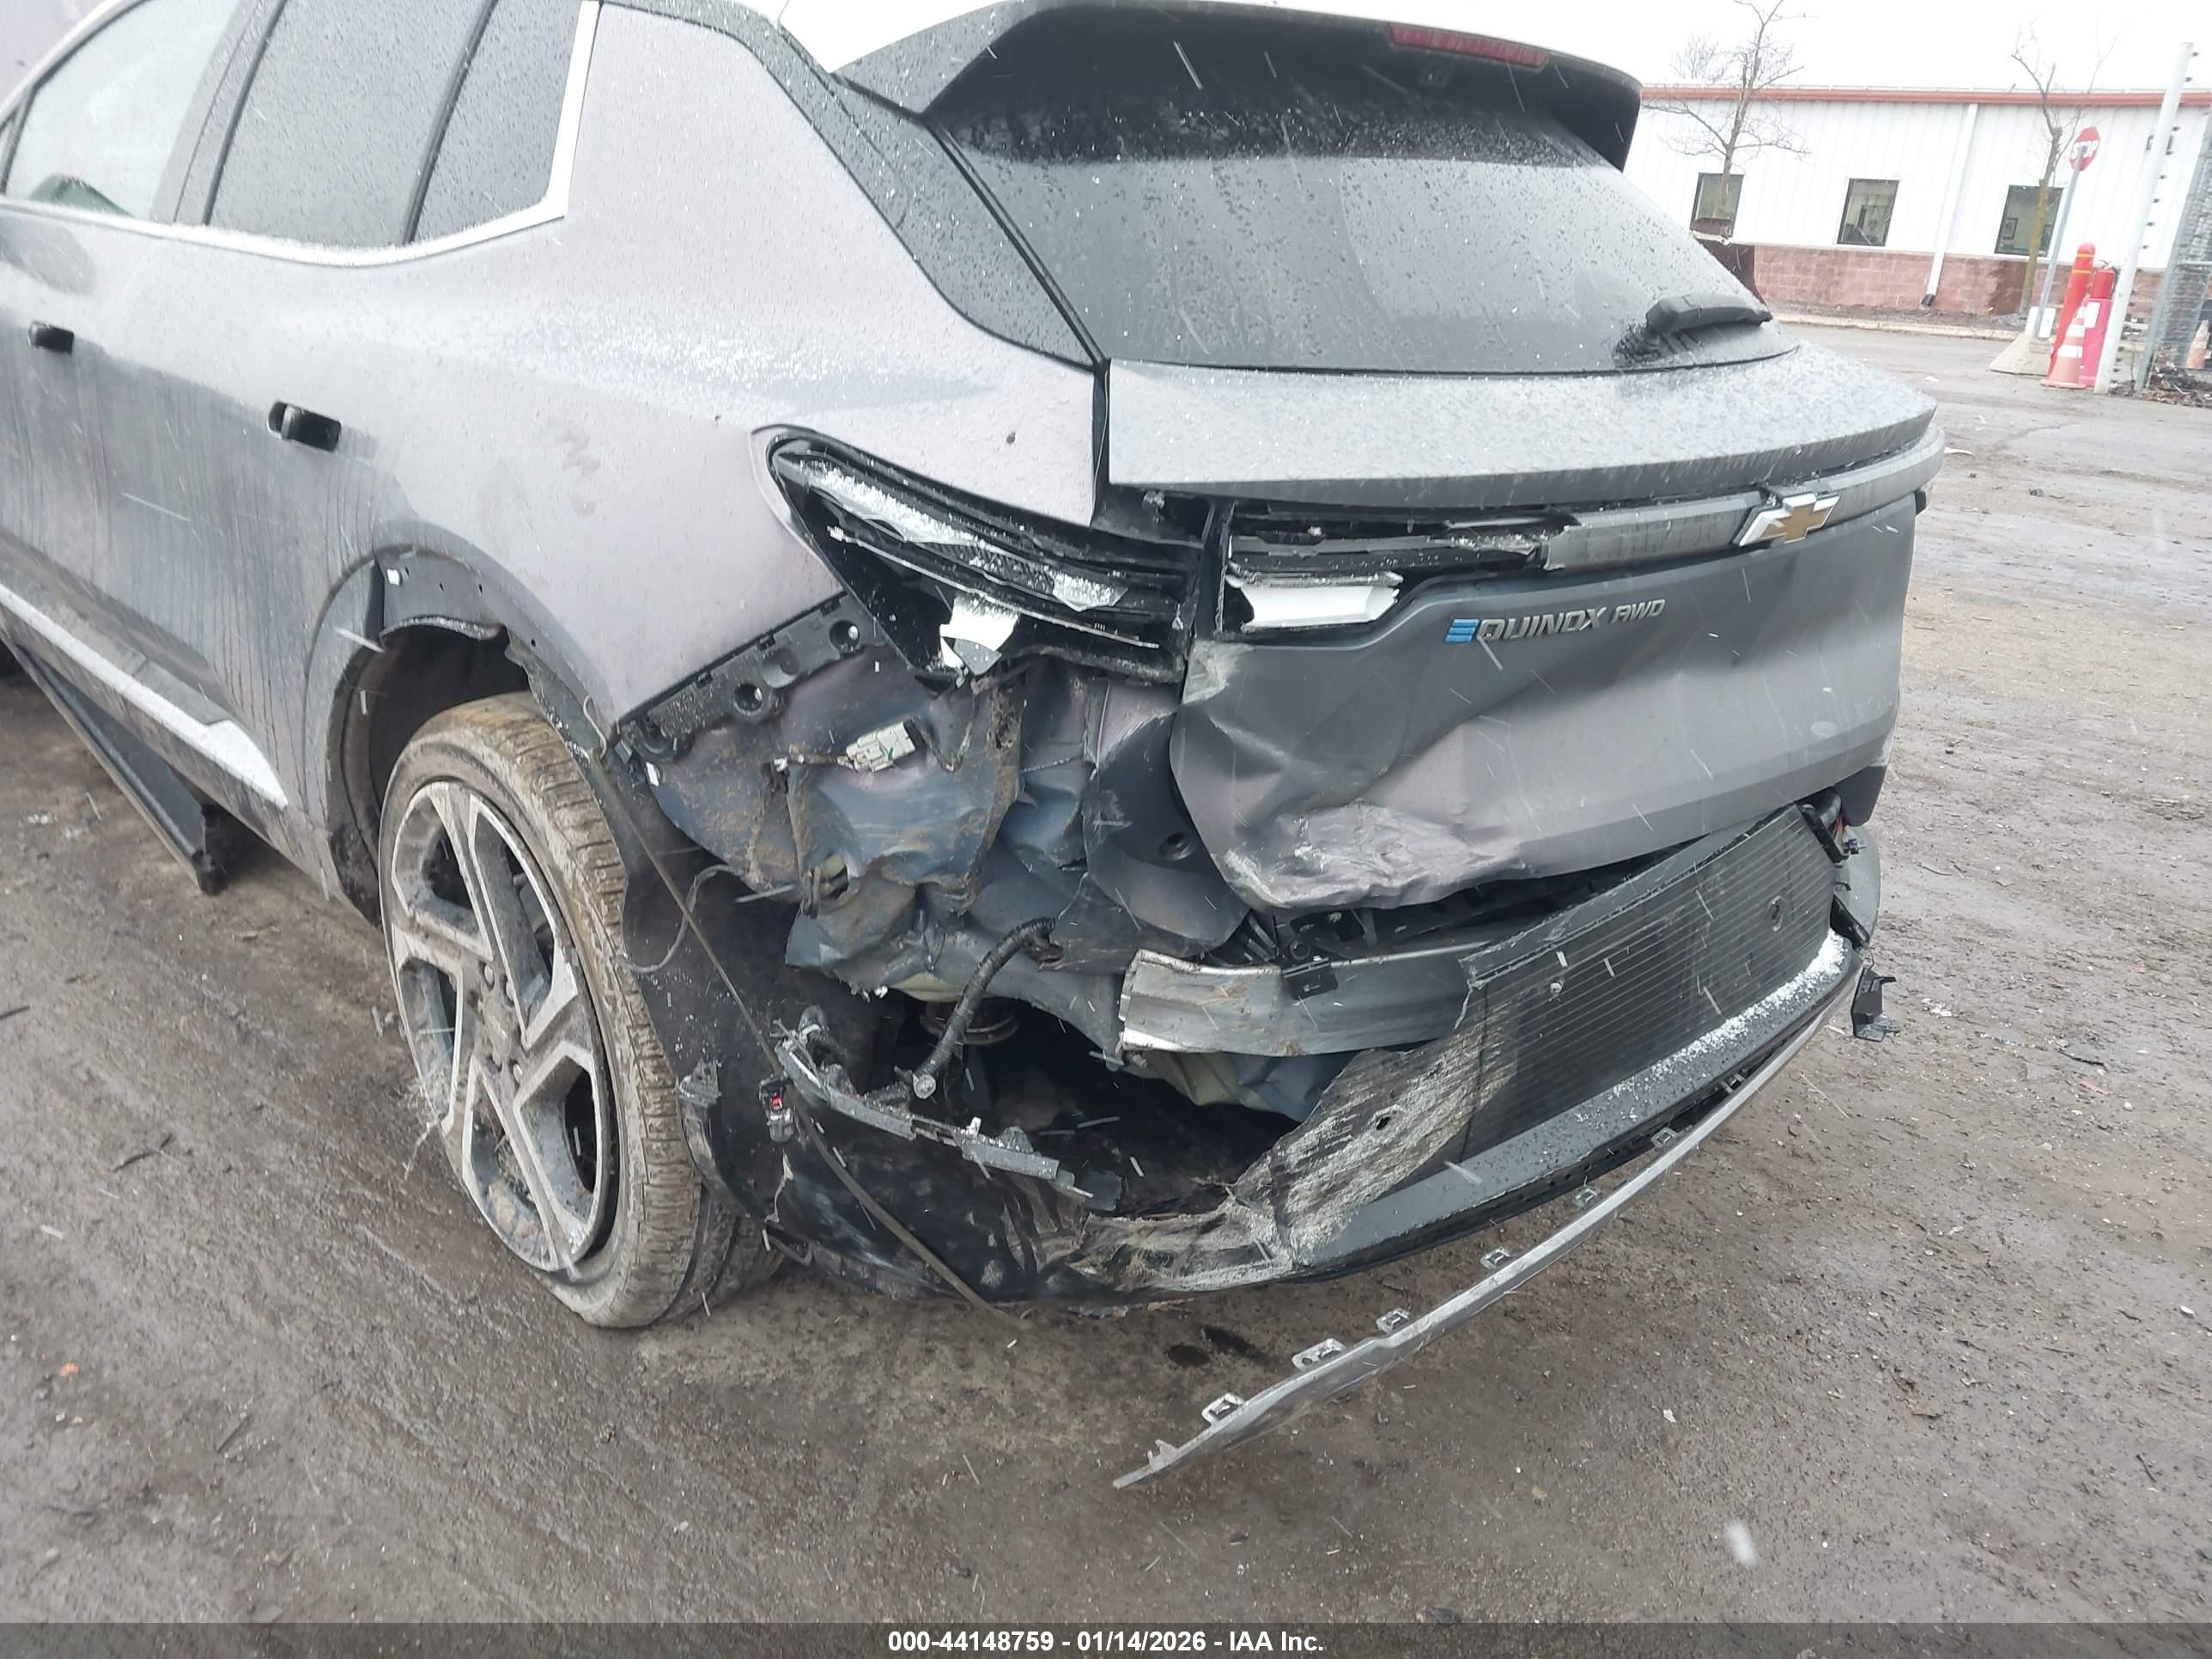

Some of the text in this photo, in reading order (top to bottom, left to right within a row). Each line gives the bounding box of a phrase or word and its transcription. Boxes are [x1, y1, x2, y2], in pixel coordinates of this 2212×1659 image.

[2070, 139, 2099, 160] STOP
[1444, 599, 1665, 642] EQUINOX AWD
